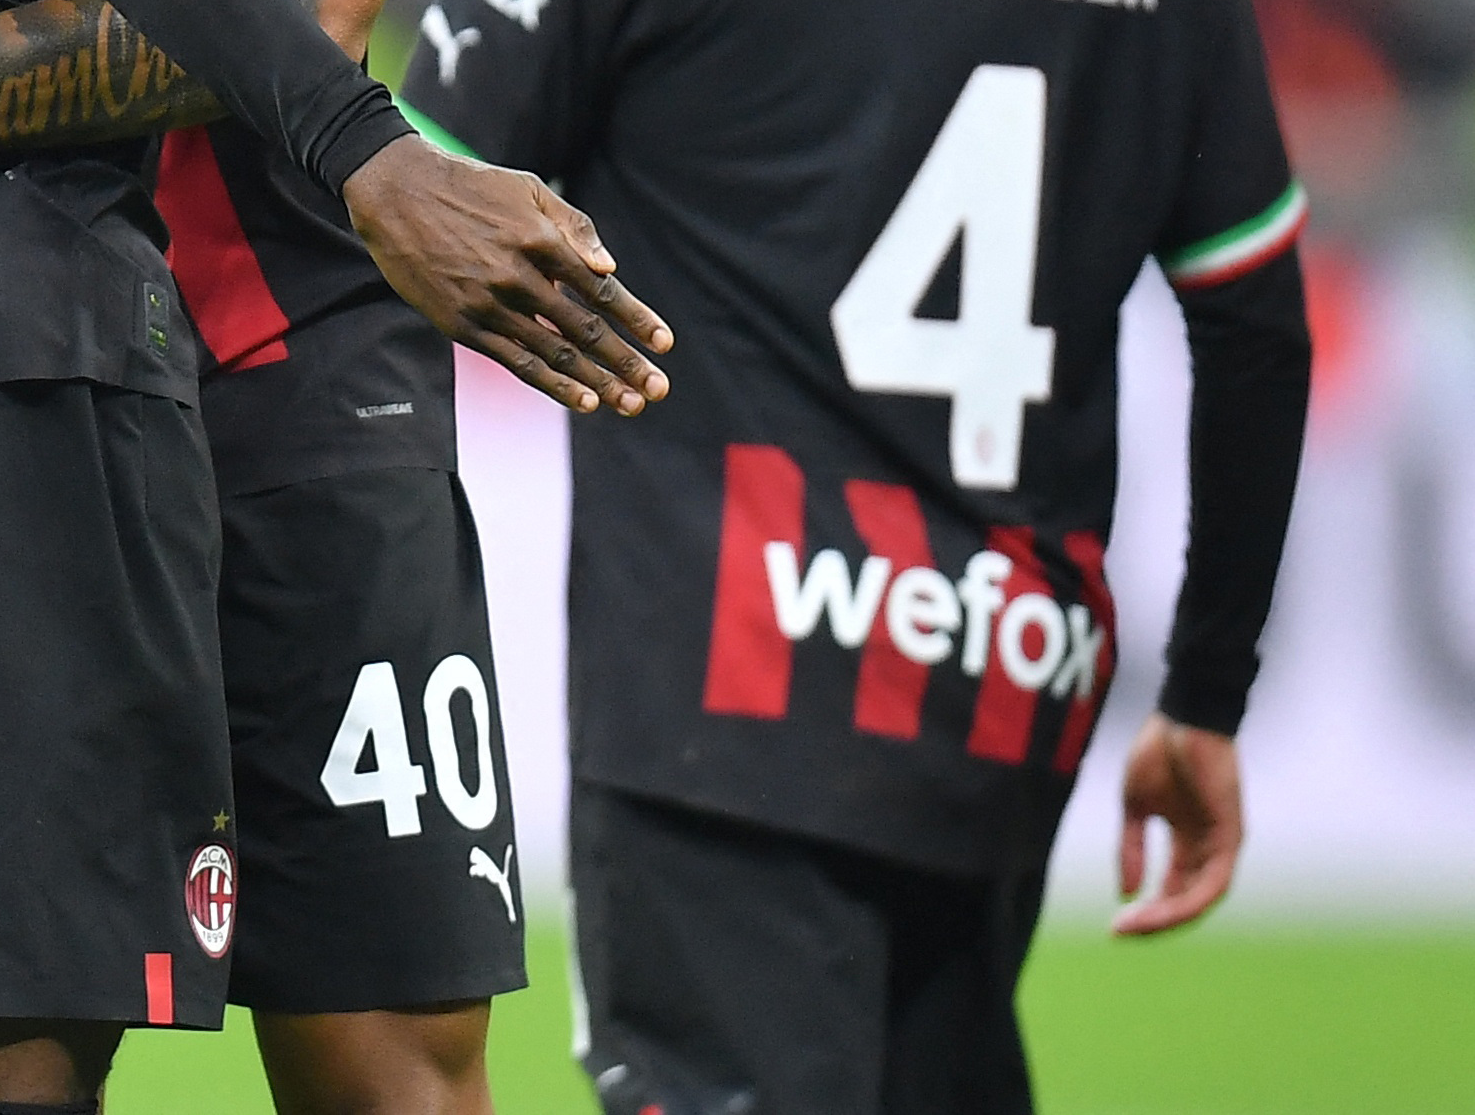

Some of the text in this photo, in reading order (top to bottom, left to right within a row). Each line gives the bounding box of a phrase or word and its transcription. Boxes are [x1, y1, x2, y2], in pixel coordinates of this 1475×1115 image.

[829, 62, 1056, 490] 4
[763, 541, 1106, 700] wefox
[320, 654, 498, 837] 40
[198, 848, 229, 871] ACM
